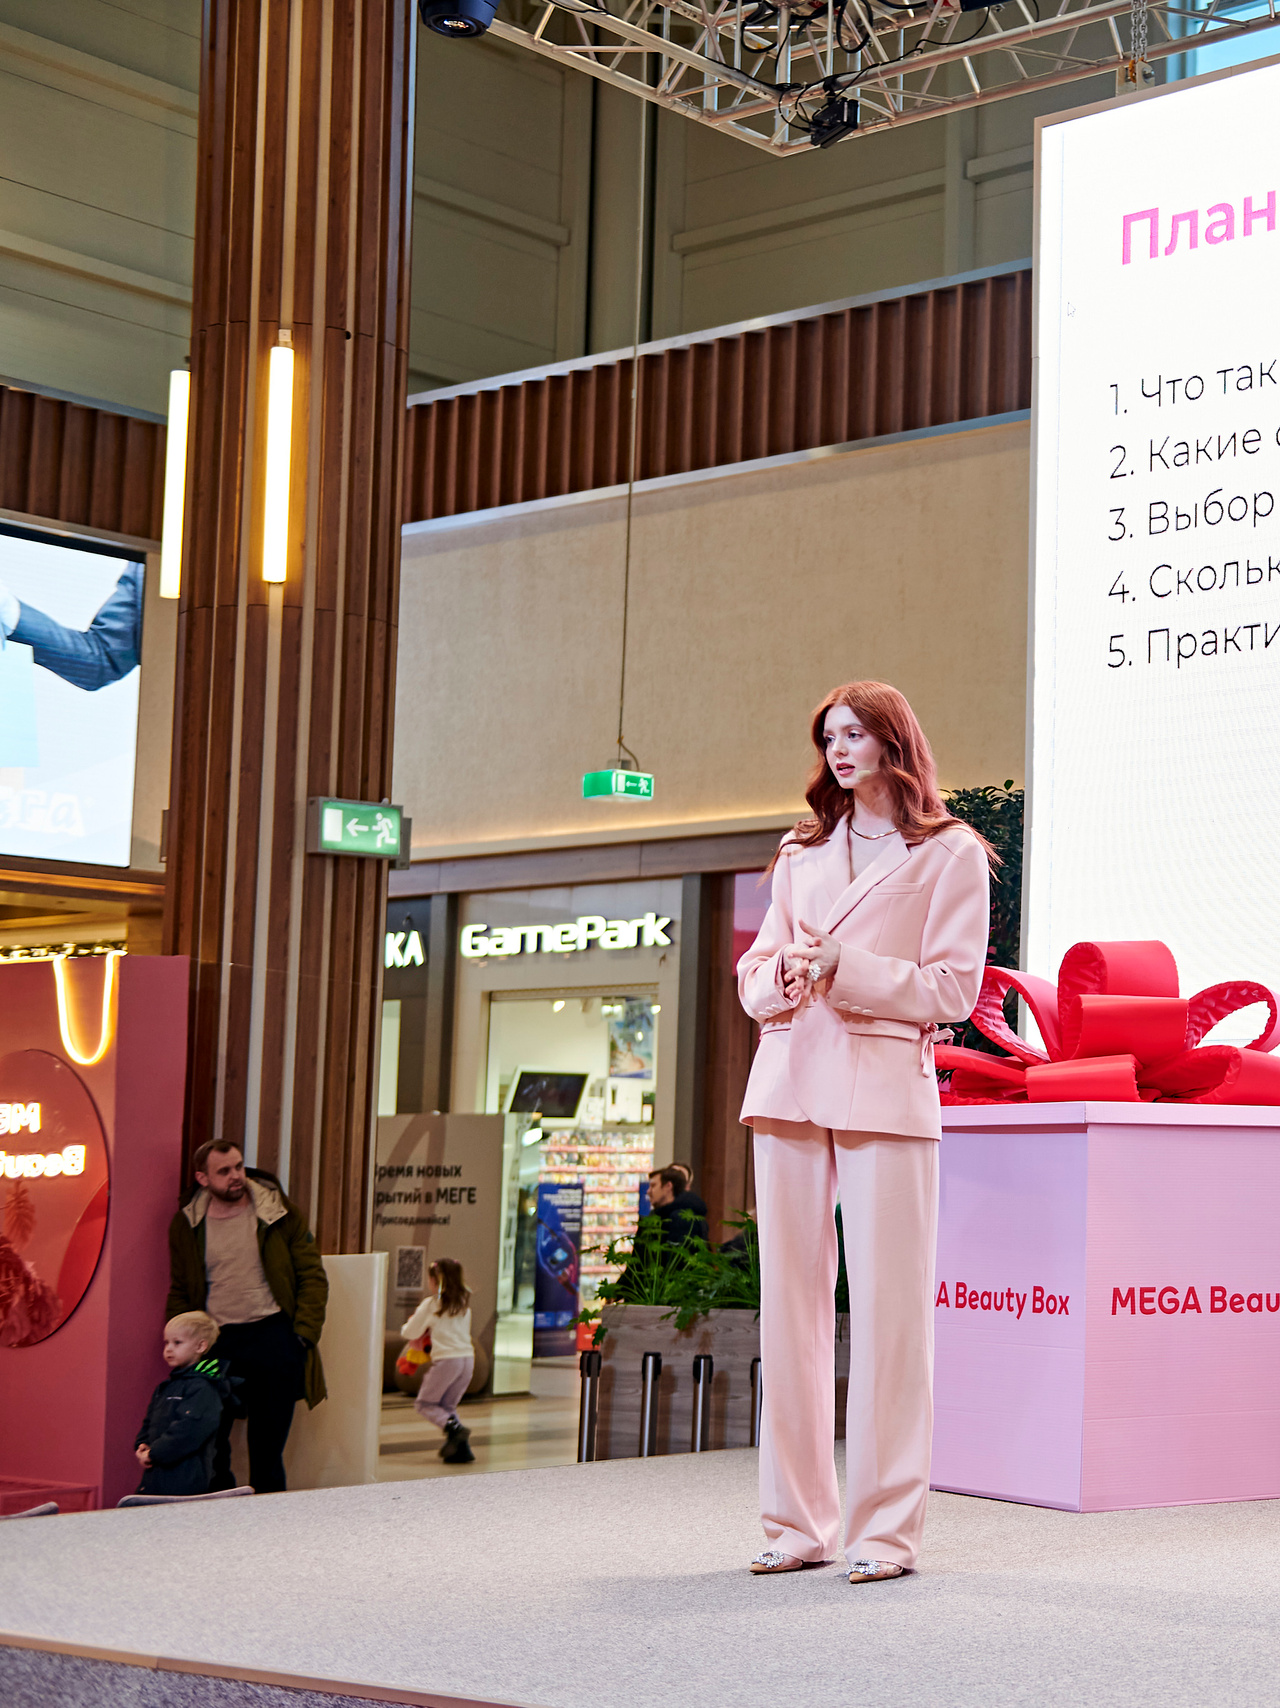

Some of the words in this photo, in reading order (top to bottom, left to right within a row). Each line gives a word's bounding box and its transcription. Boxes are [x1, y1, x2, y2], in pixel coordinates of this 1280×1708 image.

[1121, 190, 1277, 266] План
[1109, 383, 1128, 416] 1.
[1141, 374, 1205, 408] Что
[1109, 444, 1135, 480] 2.
[1149, 428, 1262, 473] Какие
[1107, 507, 1134, 542] 3.
[1148, 488, 1275, 536] Выбор
[1107, 570, 1136, 604] 4.
[1107, 633, 1133, 669] 5.
[461, 912, 671, 958] GamePark
[416, 1165, 462, 1178] новых
[375, 1188, 422, 1207] рытий
[424, 1191, 433, 1204] в
[435, 1187, 477, 1205] МЕГЕ
[954, 1281, 1028, 1320] Beauty
[1031, 1285, 1070, 1316] Box
[1111, 1285, 1203, 1316] MEGA
